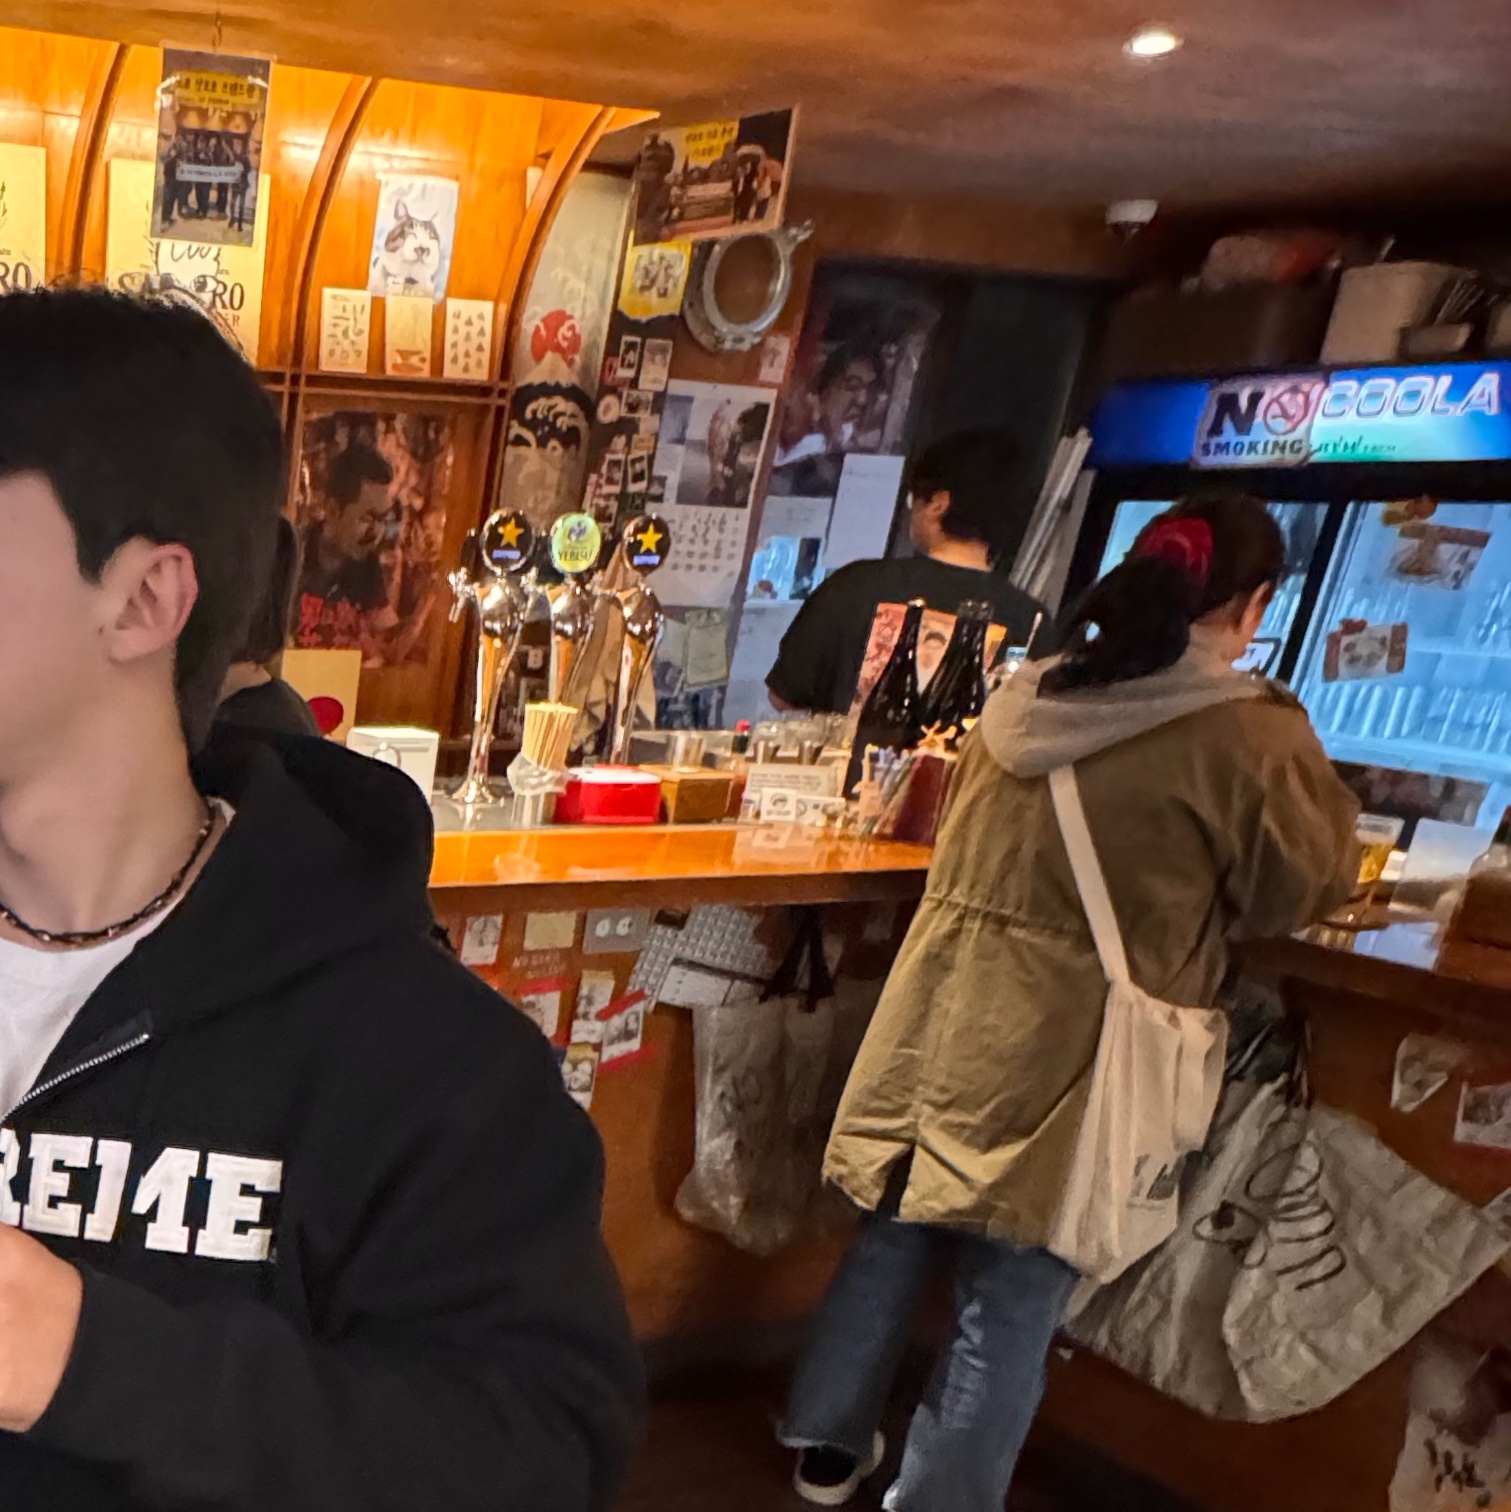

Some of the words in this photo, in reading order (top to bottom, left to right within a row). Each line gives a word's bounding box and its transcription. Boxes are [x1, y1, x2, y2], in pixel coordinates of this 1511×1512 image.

[1321, 371, 1501, 420] COOLA
[1199, 438, 1305, 458] SMOKING
[557, 549, 594, 563] YEBISU
